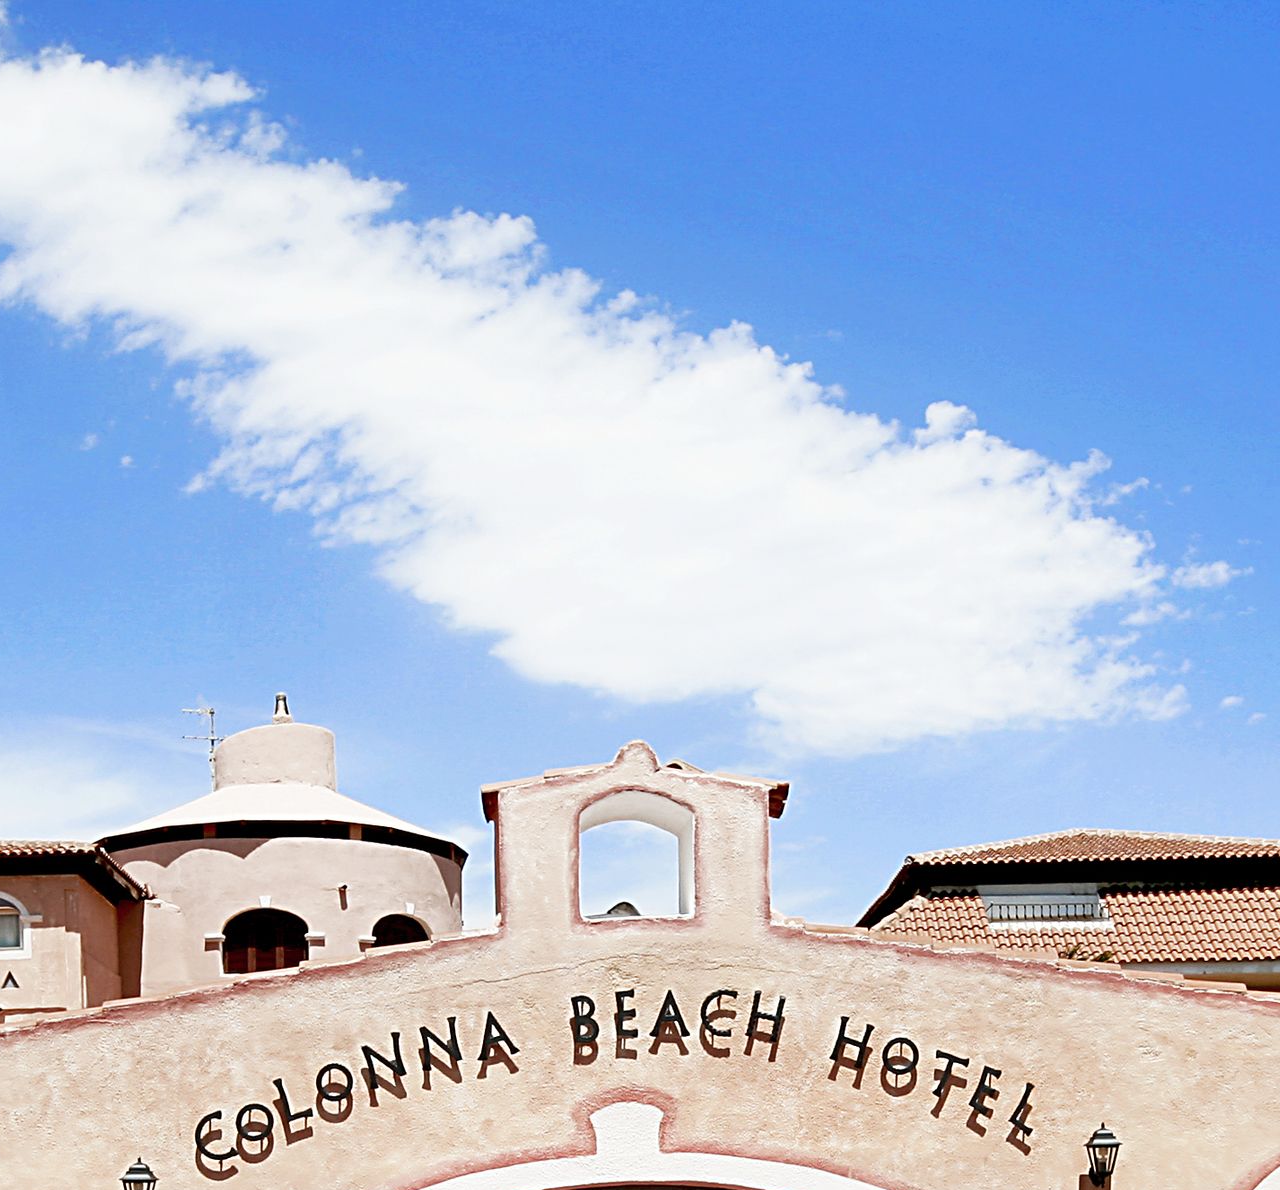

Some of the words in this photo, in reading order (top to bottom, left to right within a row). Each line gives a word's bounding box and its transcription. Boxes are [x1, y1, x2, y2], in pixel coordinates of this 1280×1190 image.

[195, 1011, 521, 1160] COLONNA
[570, 988, 786, 1043] BEACH
[829, 1016, 1035, 1137] HOTEL
